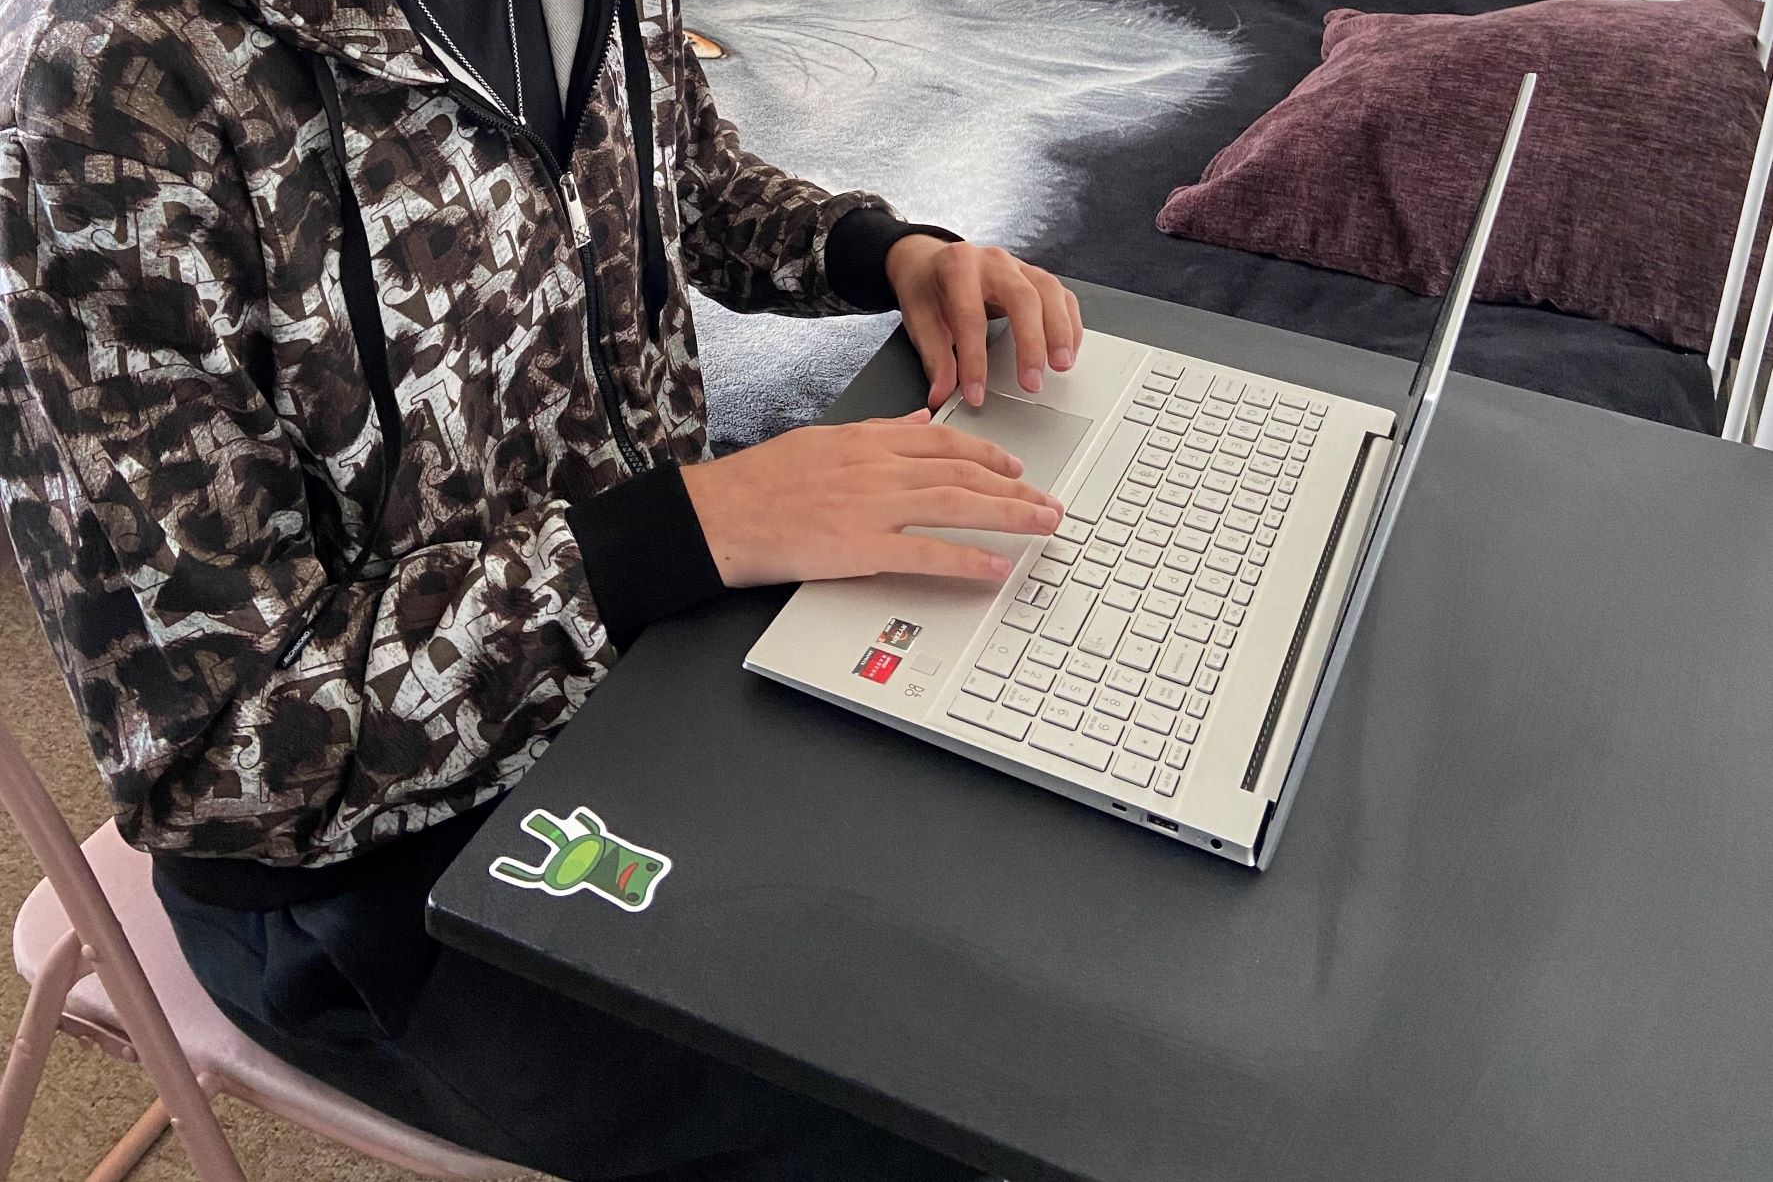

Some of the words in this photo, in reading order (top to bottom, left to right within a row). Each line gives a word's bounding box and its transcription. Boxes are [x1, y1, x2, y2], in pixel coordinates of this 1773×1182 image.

[1175, 402, 1189, 411] Z
[1245, 408, 1258, 417] Q
[1167, 418, 1180, 427] X
[1238, 424, 1250, 434] W
[1158, 435, 1171, 443] C
[1195, 435, 1208, 444] D
[1230, 441, 1243, 449] E
[1149, 453, 1162, 461] V
[1188, 453, 1199, 461] F
[1222, 458, 1235, 467] R
[1177, 471, 1190, 479] G
[1128, 488, 1142, 497] N
[1168, 489, 1180, 498] H
[1205, 496, 1217, 504] Y
[1118, 506, 1132, 517] M
[1157, 508, 1169, 517] J
[1195, 514, 1209, 523] U
[1147, 527, 1160, 537] K
[1176, 553, 1189, 563] O
[1167, 575, 1180, 584] P
[890, 624, 907, 644] RYZEN
[283, 631, 310, 663] RICHMOND
[997, 645, 1009, 654] 0
[1080, 661, 1092, 669] 4
[1029, 670, 1042, 680] 2
[1120, 674, 1133, 684] 7
[1069, 684, 1082, 693] 5
[1017, 693, 1031, 703] 3
[1108, 697, 1121, 707] 8
[1056, 708, 1069, 717] 6
[1097, 722, 1110, 731] 9
